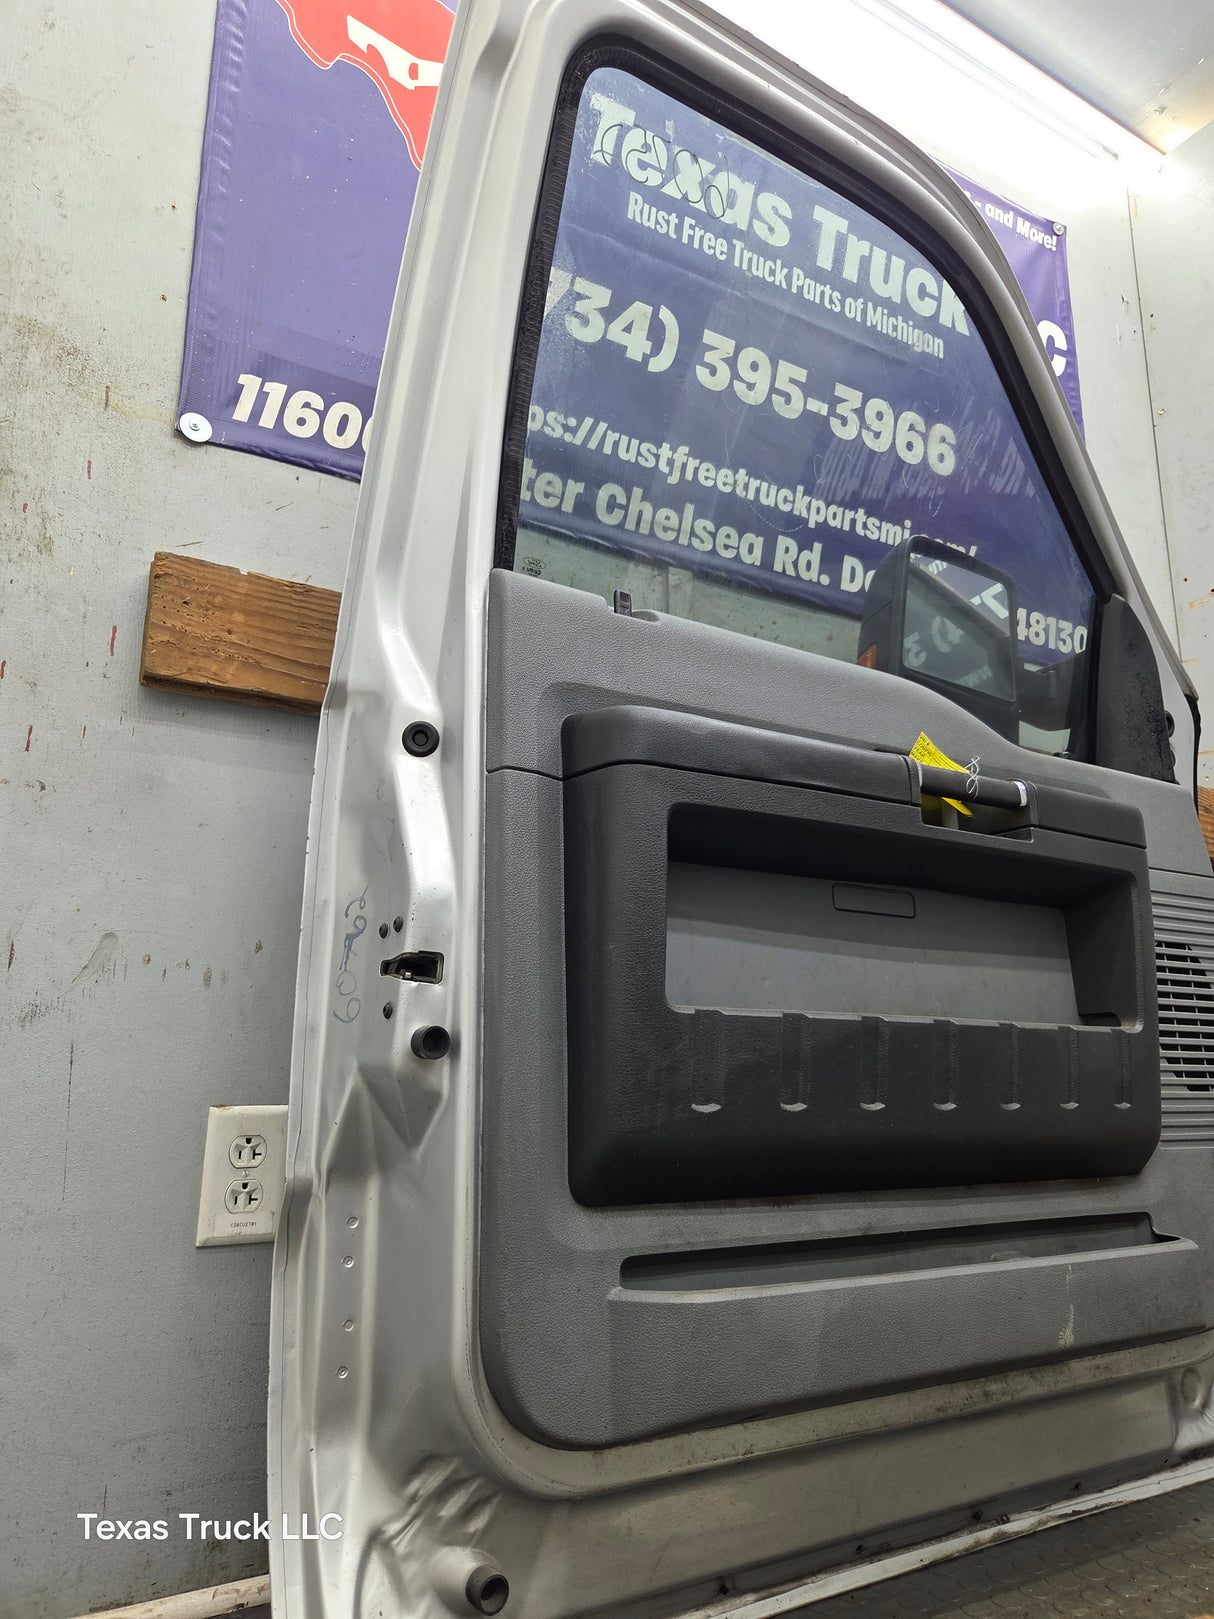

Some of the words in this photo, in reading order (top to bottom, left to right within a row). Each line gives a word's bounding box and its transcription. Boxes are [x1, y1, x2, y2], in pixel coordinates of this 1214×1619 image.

[589, 92, 792, 247] Texas
[984, 203, 1014, 228] and
[1016, 216, 1058, 252] More!
[627, 190, 679, 240] Rust
[682, 216, 728, 261] Free
[732, 238, 788, 290] Truck
[791, 266, 842, 314] Parts
[844, 297, 865, 323] of
[866, 302, 944, 359] Michigan
[232, 373, 373, 454] 1160
[695, 328, 957, 476] 395-3966
[595, 482, 764, 567] Chelsea
[773, 534, 830, 586] Rd.
